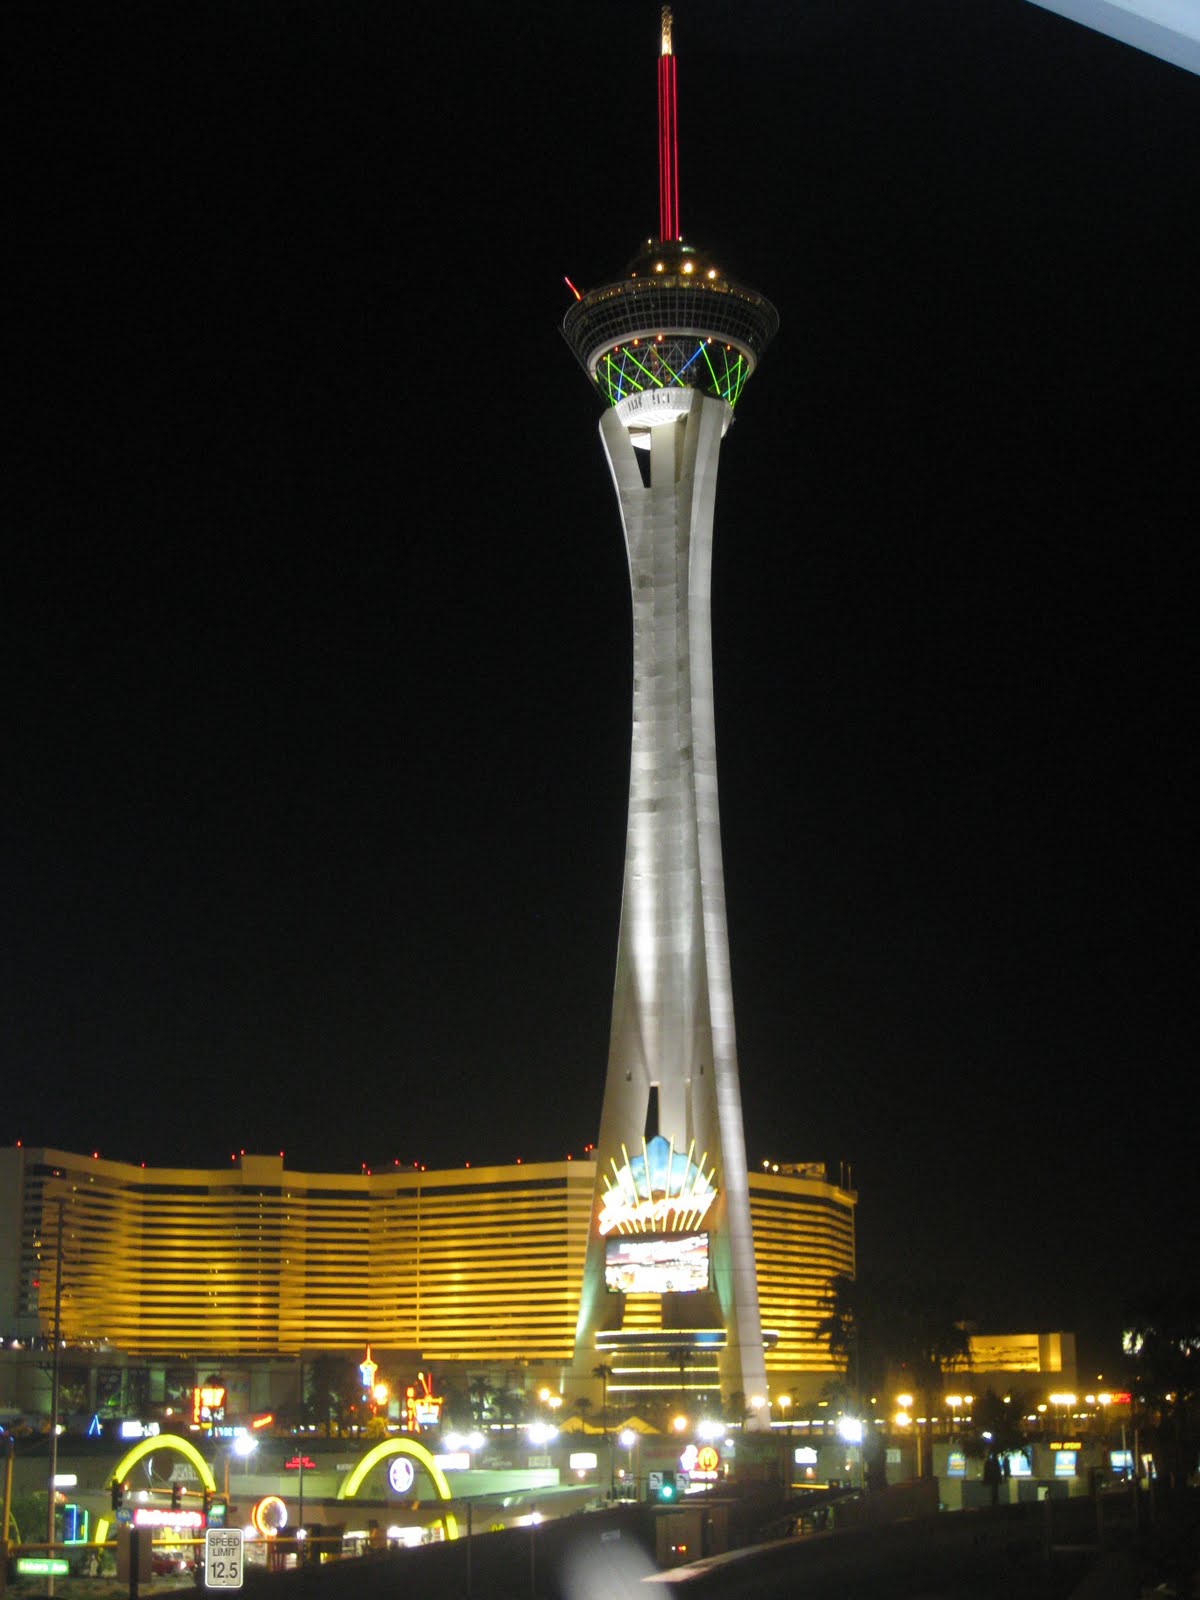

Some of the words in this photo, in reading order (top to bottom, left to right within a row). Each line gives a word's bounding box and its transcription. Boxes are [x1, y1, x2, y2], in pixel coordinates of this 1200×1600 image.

[209, 1537, 240, 1547] SPEED
[212, 1548, 237, 1557] LIMIT
[210, 1561, 238, 1579] 12.5
